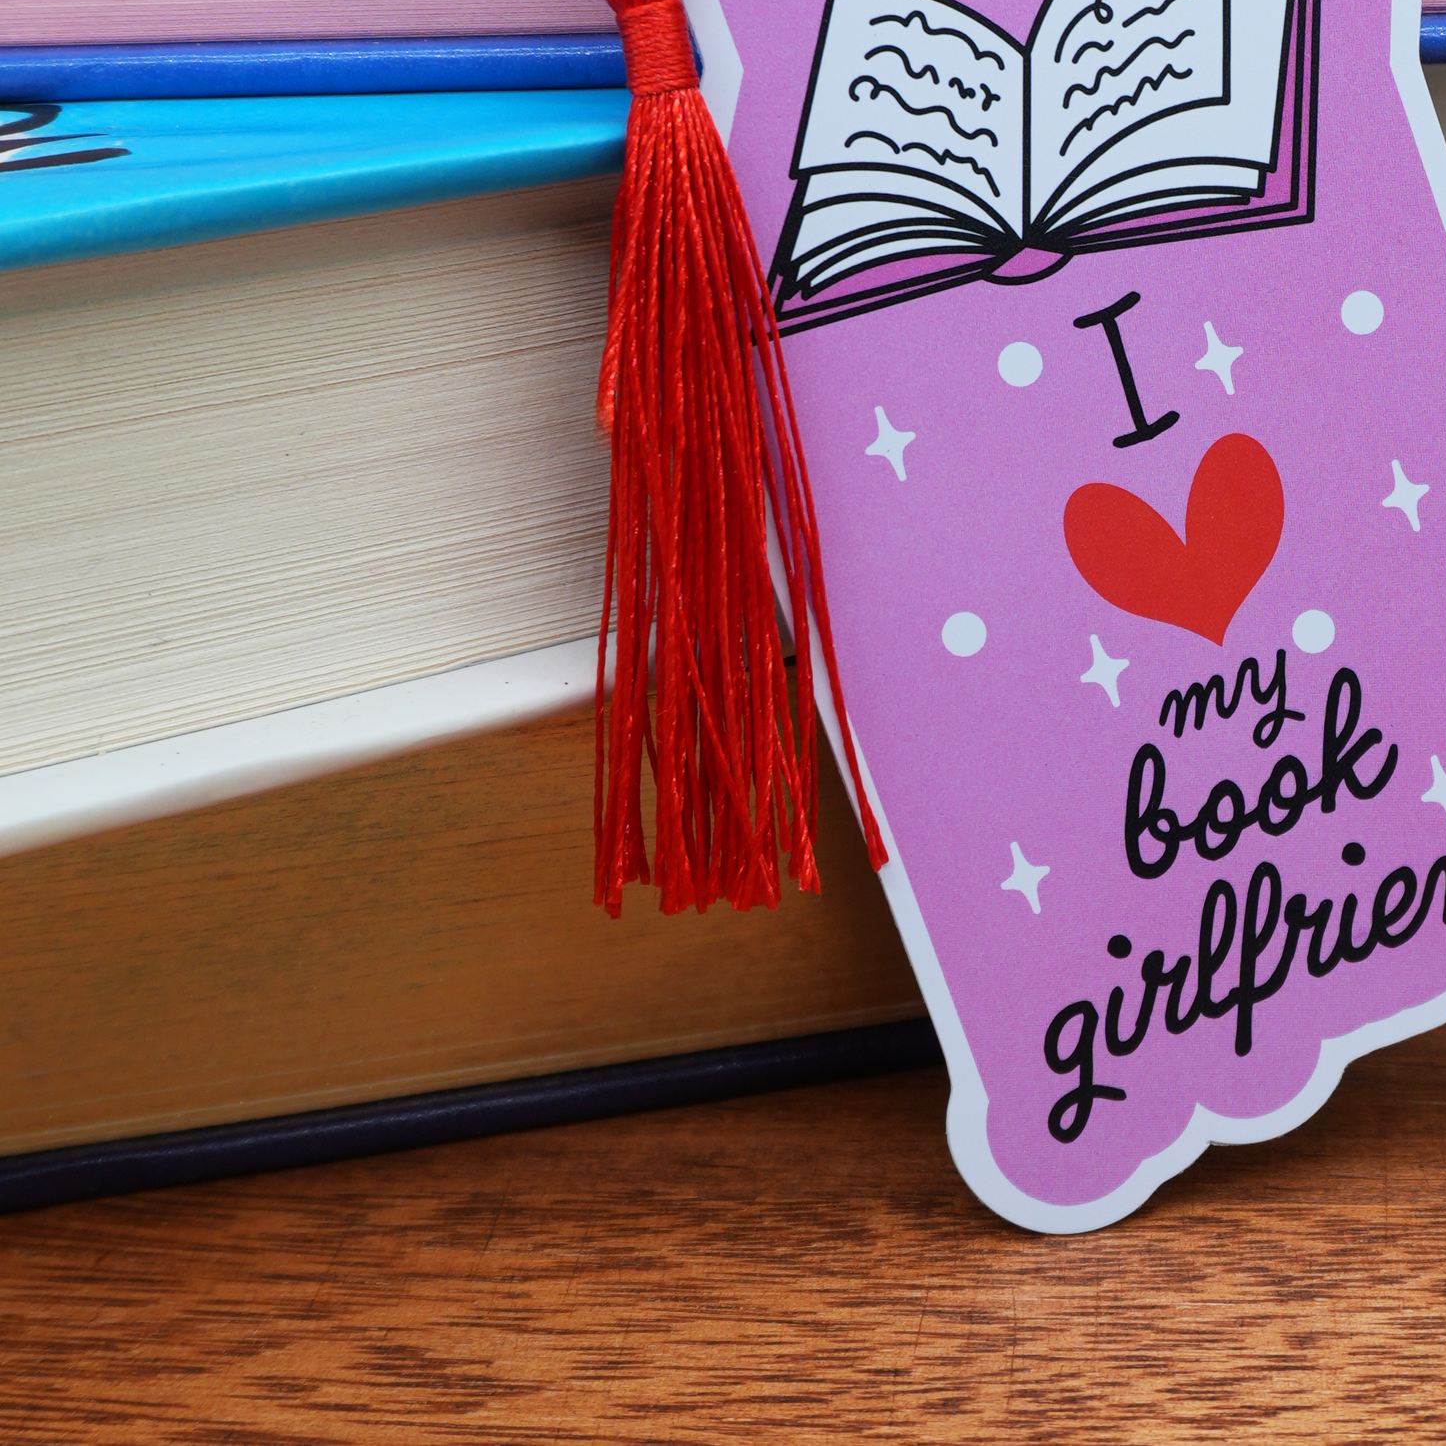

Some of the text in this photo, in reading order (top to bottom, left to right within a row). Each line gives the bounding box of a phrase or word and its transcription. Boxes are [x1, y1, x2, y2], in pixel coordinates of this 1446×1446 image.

[1073, 290, 1180, 449] I
[1124, 666, 1399, 880] book
[1158, 648, 1306, 750] my
